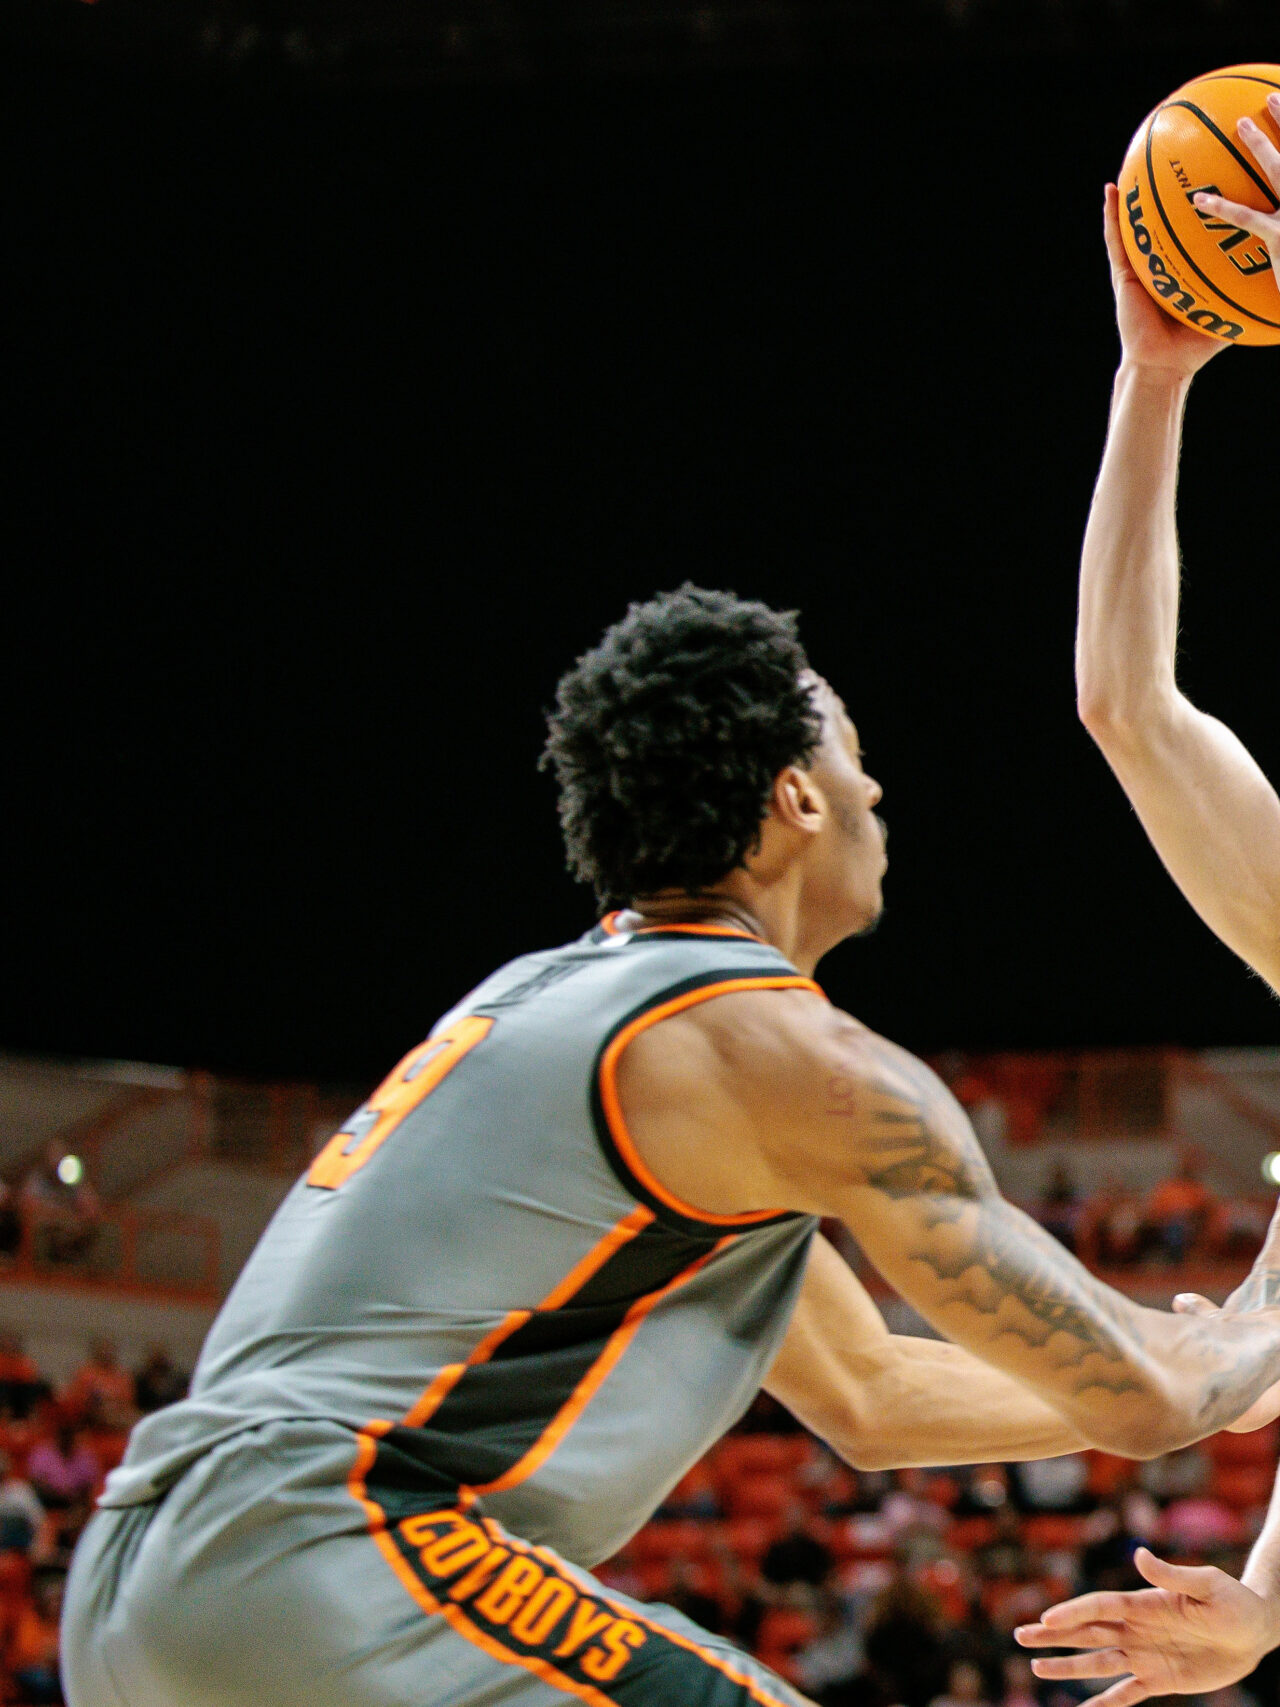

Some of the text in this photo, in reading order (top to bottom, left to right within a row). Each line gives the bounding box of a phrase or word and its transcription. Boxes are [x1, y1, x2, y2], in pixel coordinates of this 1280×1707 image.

[1169, 159, 1192, 189] NXT
[1126, 184, 1245, 341] Wilson
[306, 1015, 497, 1191] 9
